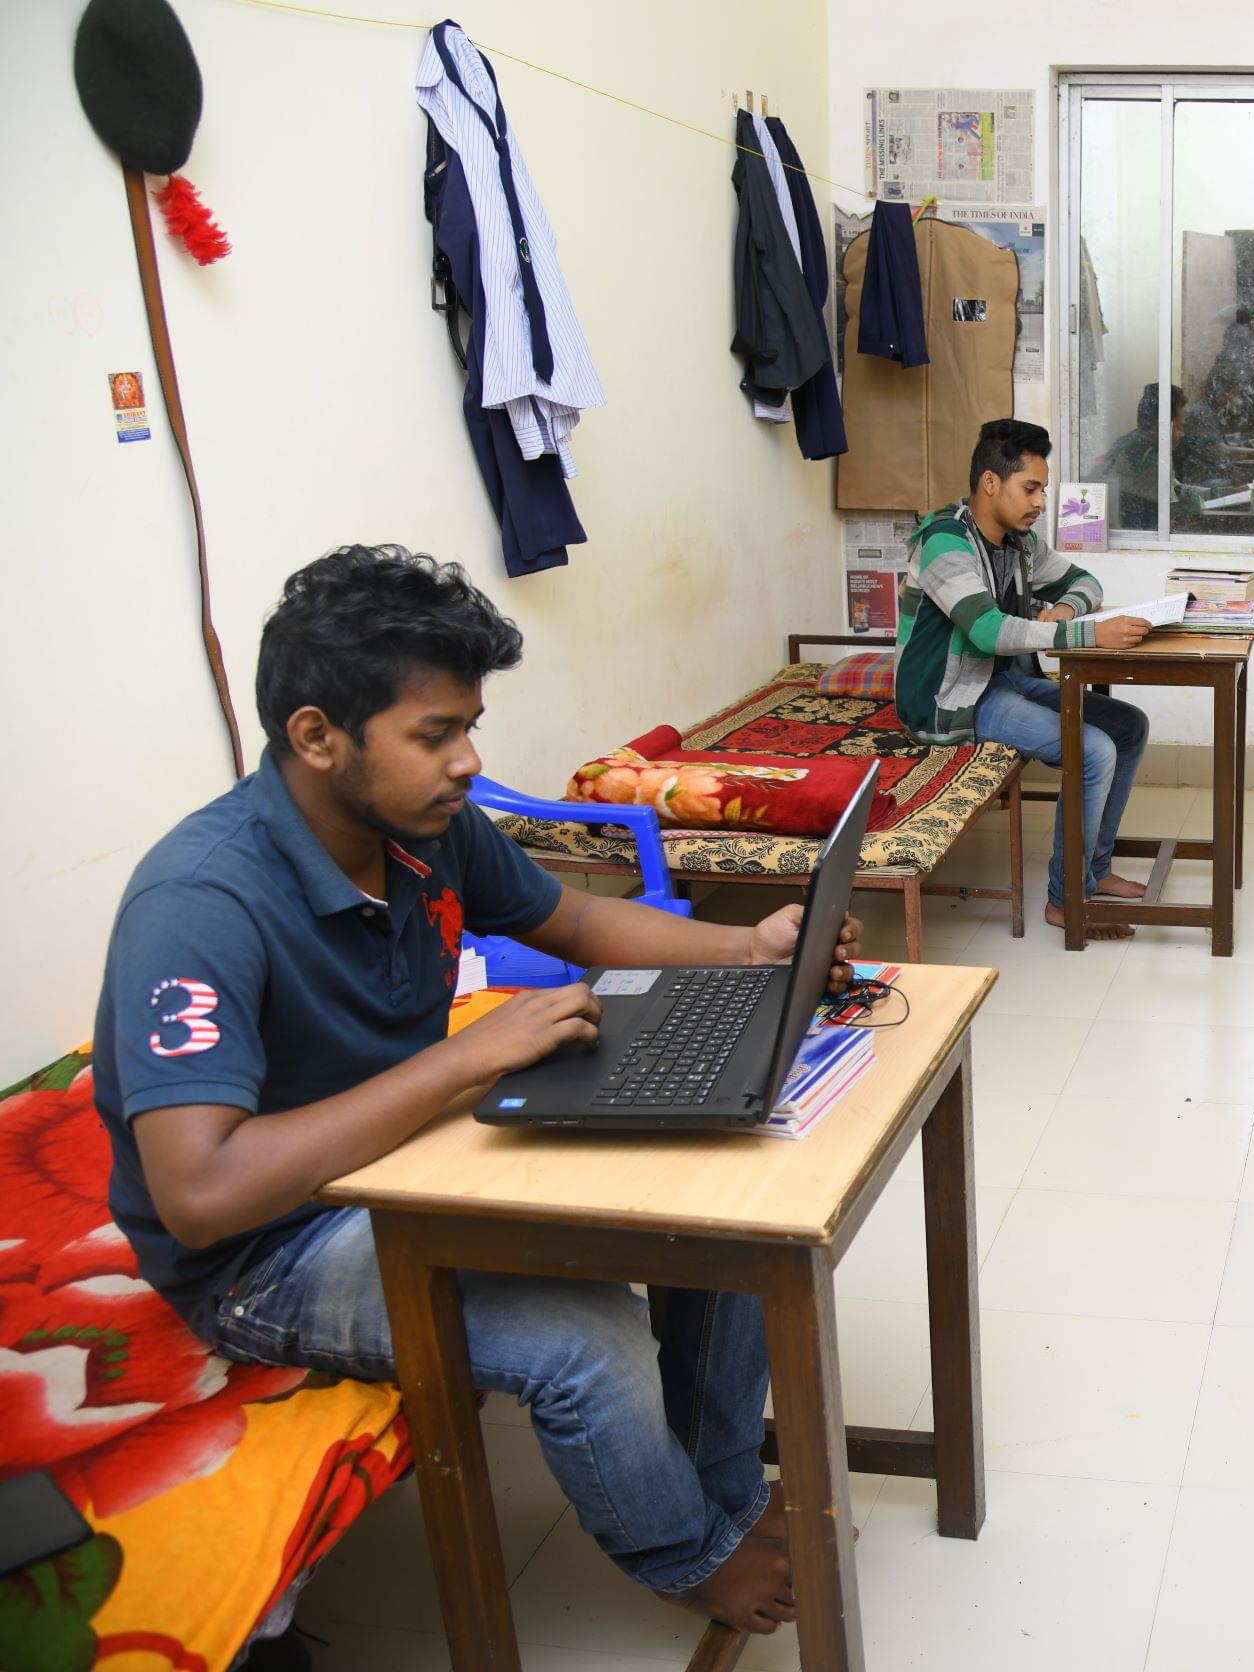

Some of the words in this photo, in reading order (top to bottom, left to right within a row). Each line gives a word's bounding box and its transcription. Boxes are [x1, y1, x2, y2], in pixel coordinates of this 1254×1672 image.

[952, 210, 968, 218] THE
[997, 211, 1007, 219] OF
[1010, 211, 1034, 219] INDIA
[150, 977, 221, 1058] 3
